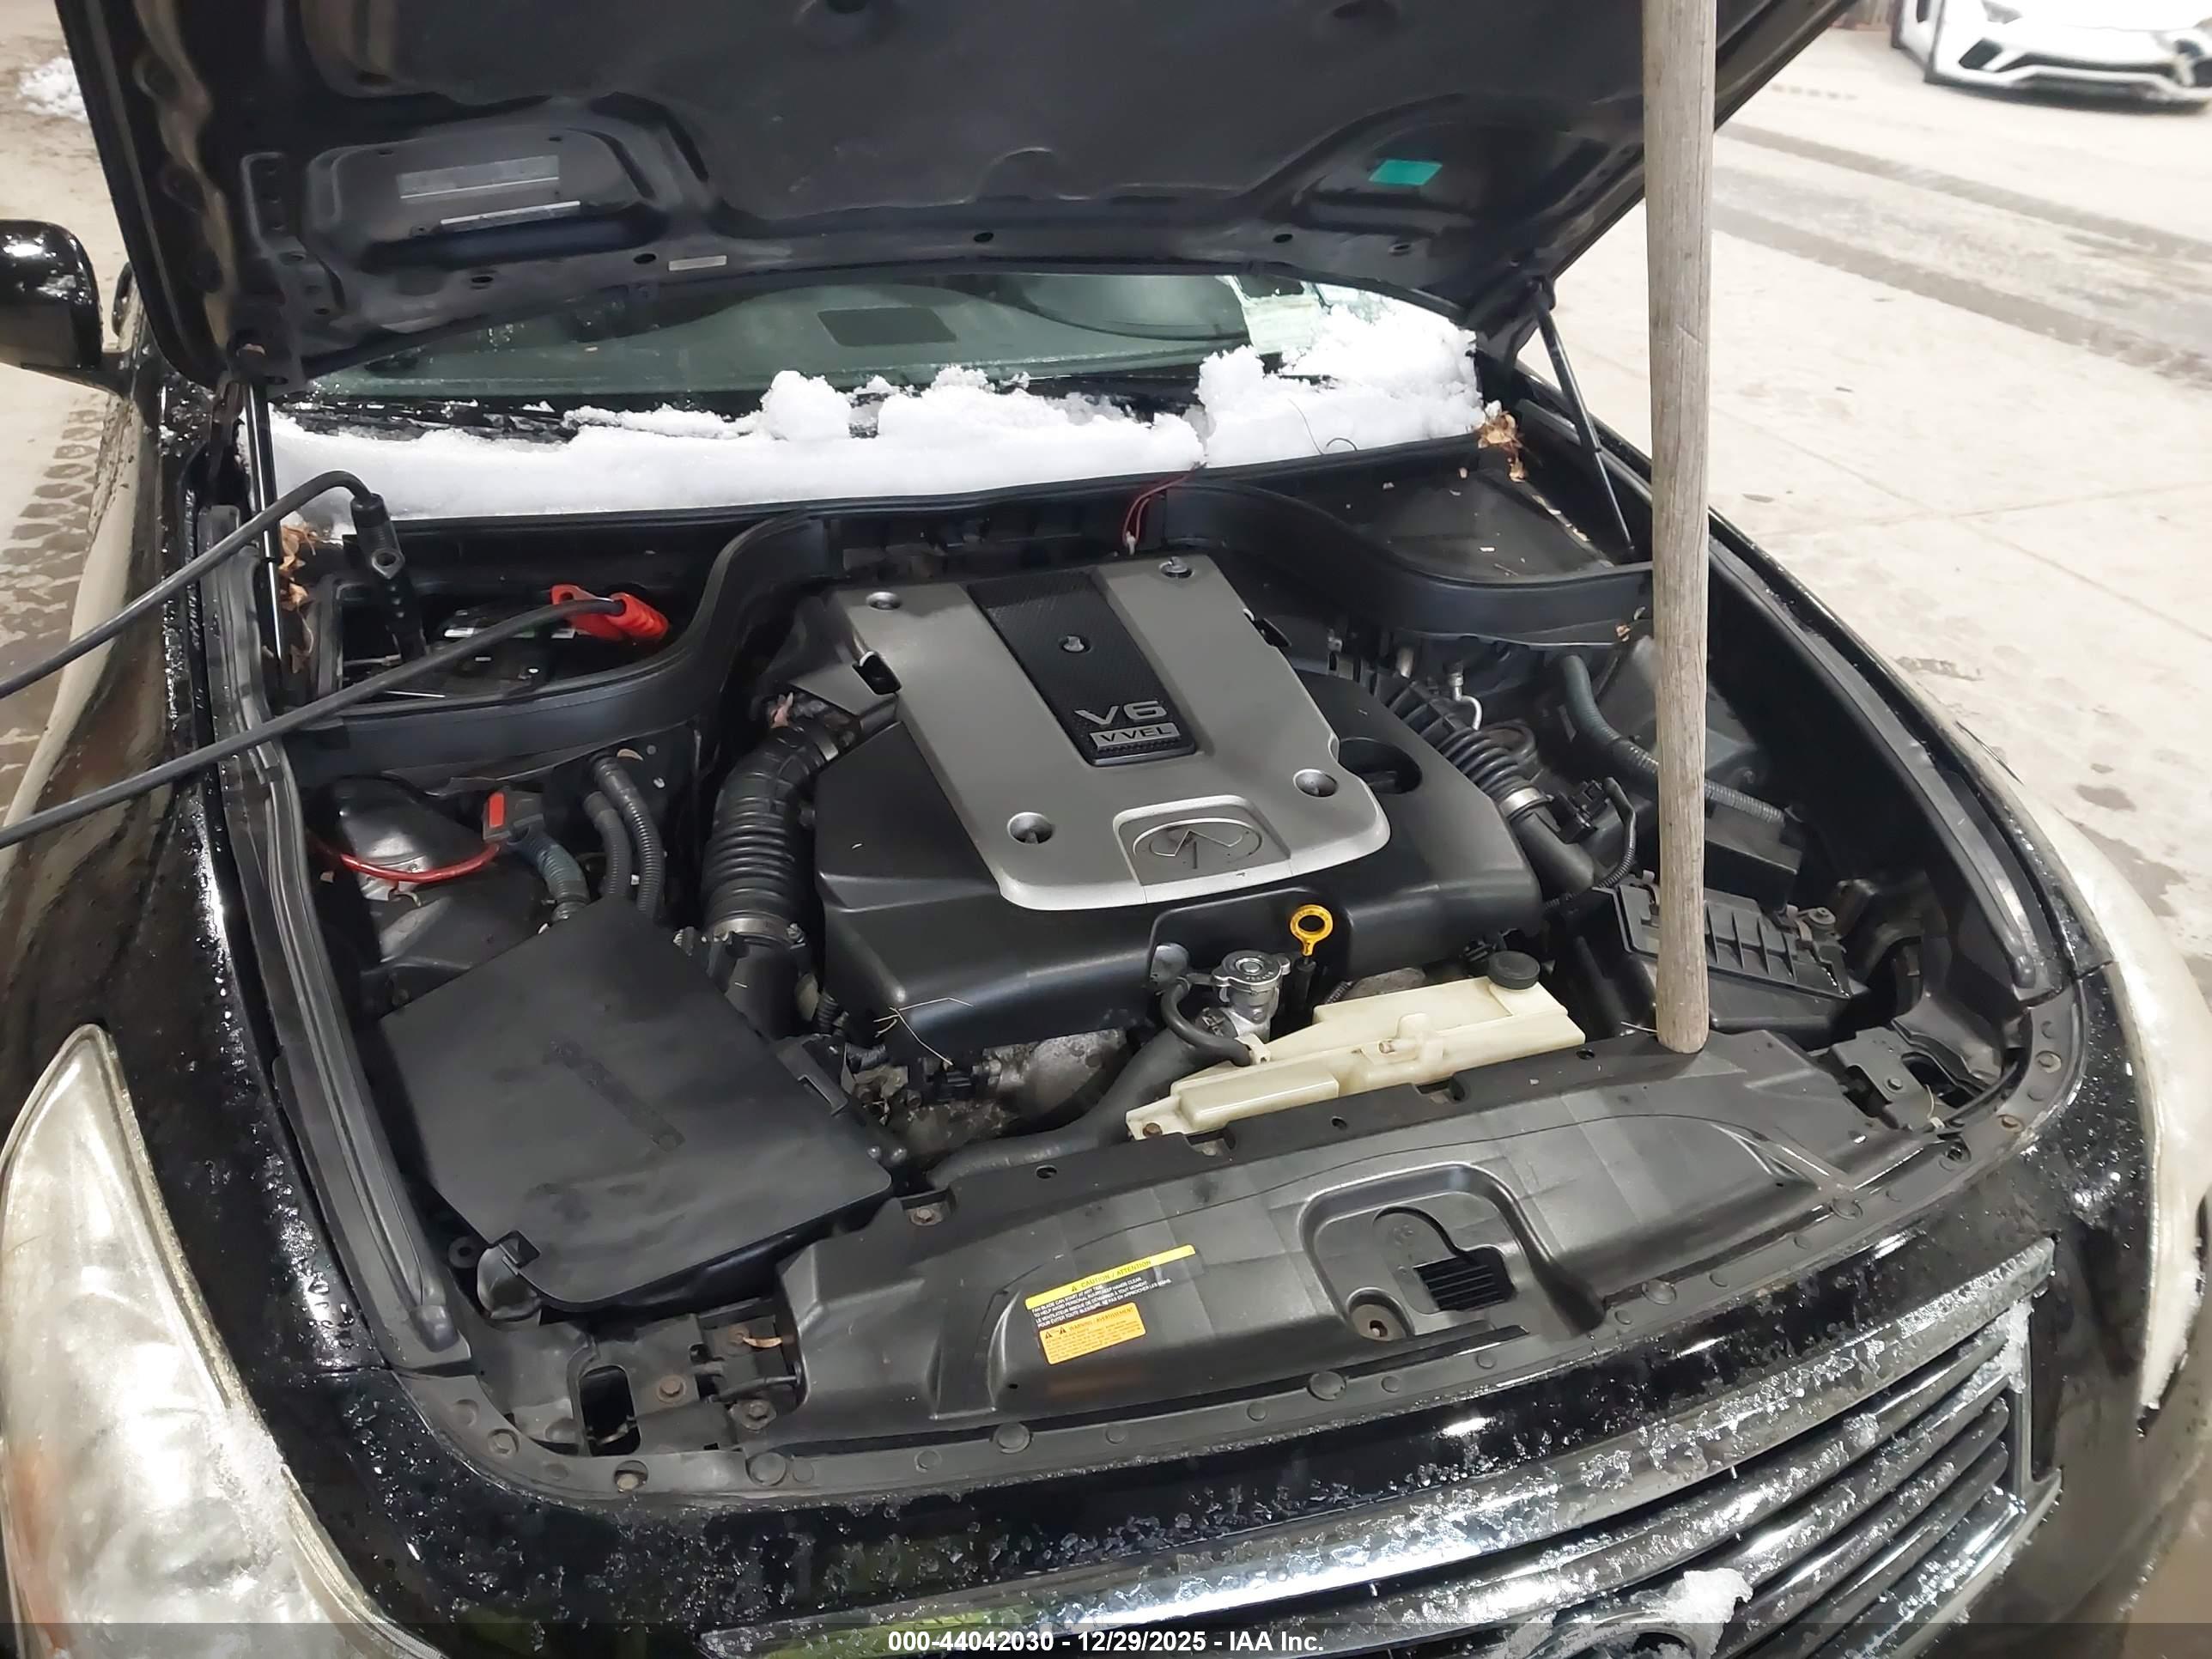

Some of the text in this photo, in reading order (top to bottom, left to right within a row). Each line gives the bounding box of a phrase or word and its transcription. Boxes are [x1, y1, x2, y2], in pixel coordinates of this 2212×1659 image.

[1074, 701, 1167, 725] V6
[1100, 726, 1172, 742] VVEL
[1080, 1274, 1109, 1288] CAUTION
[1116, 1260, 1152, 1276] ATTENTION
